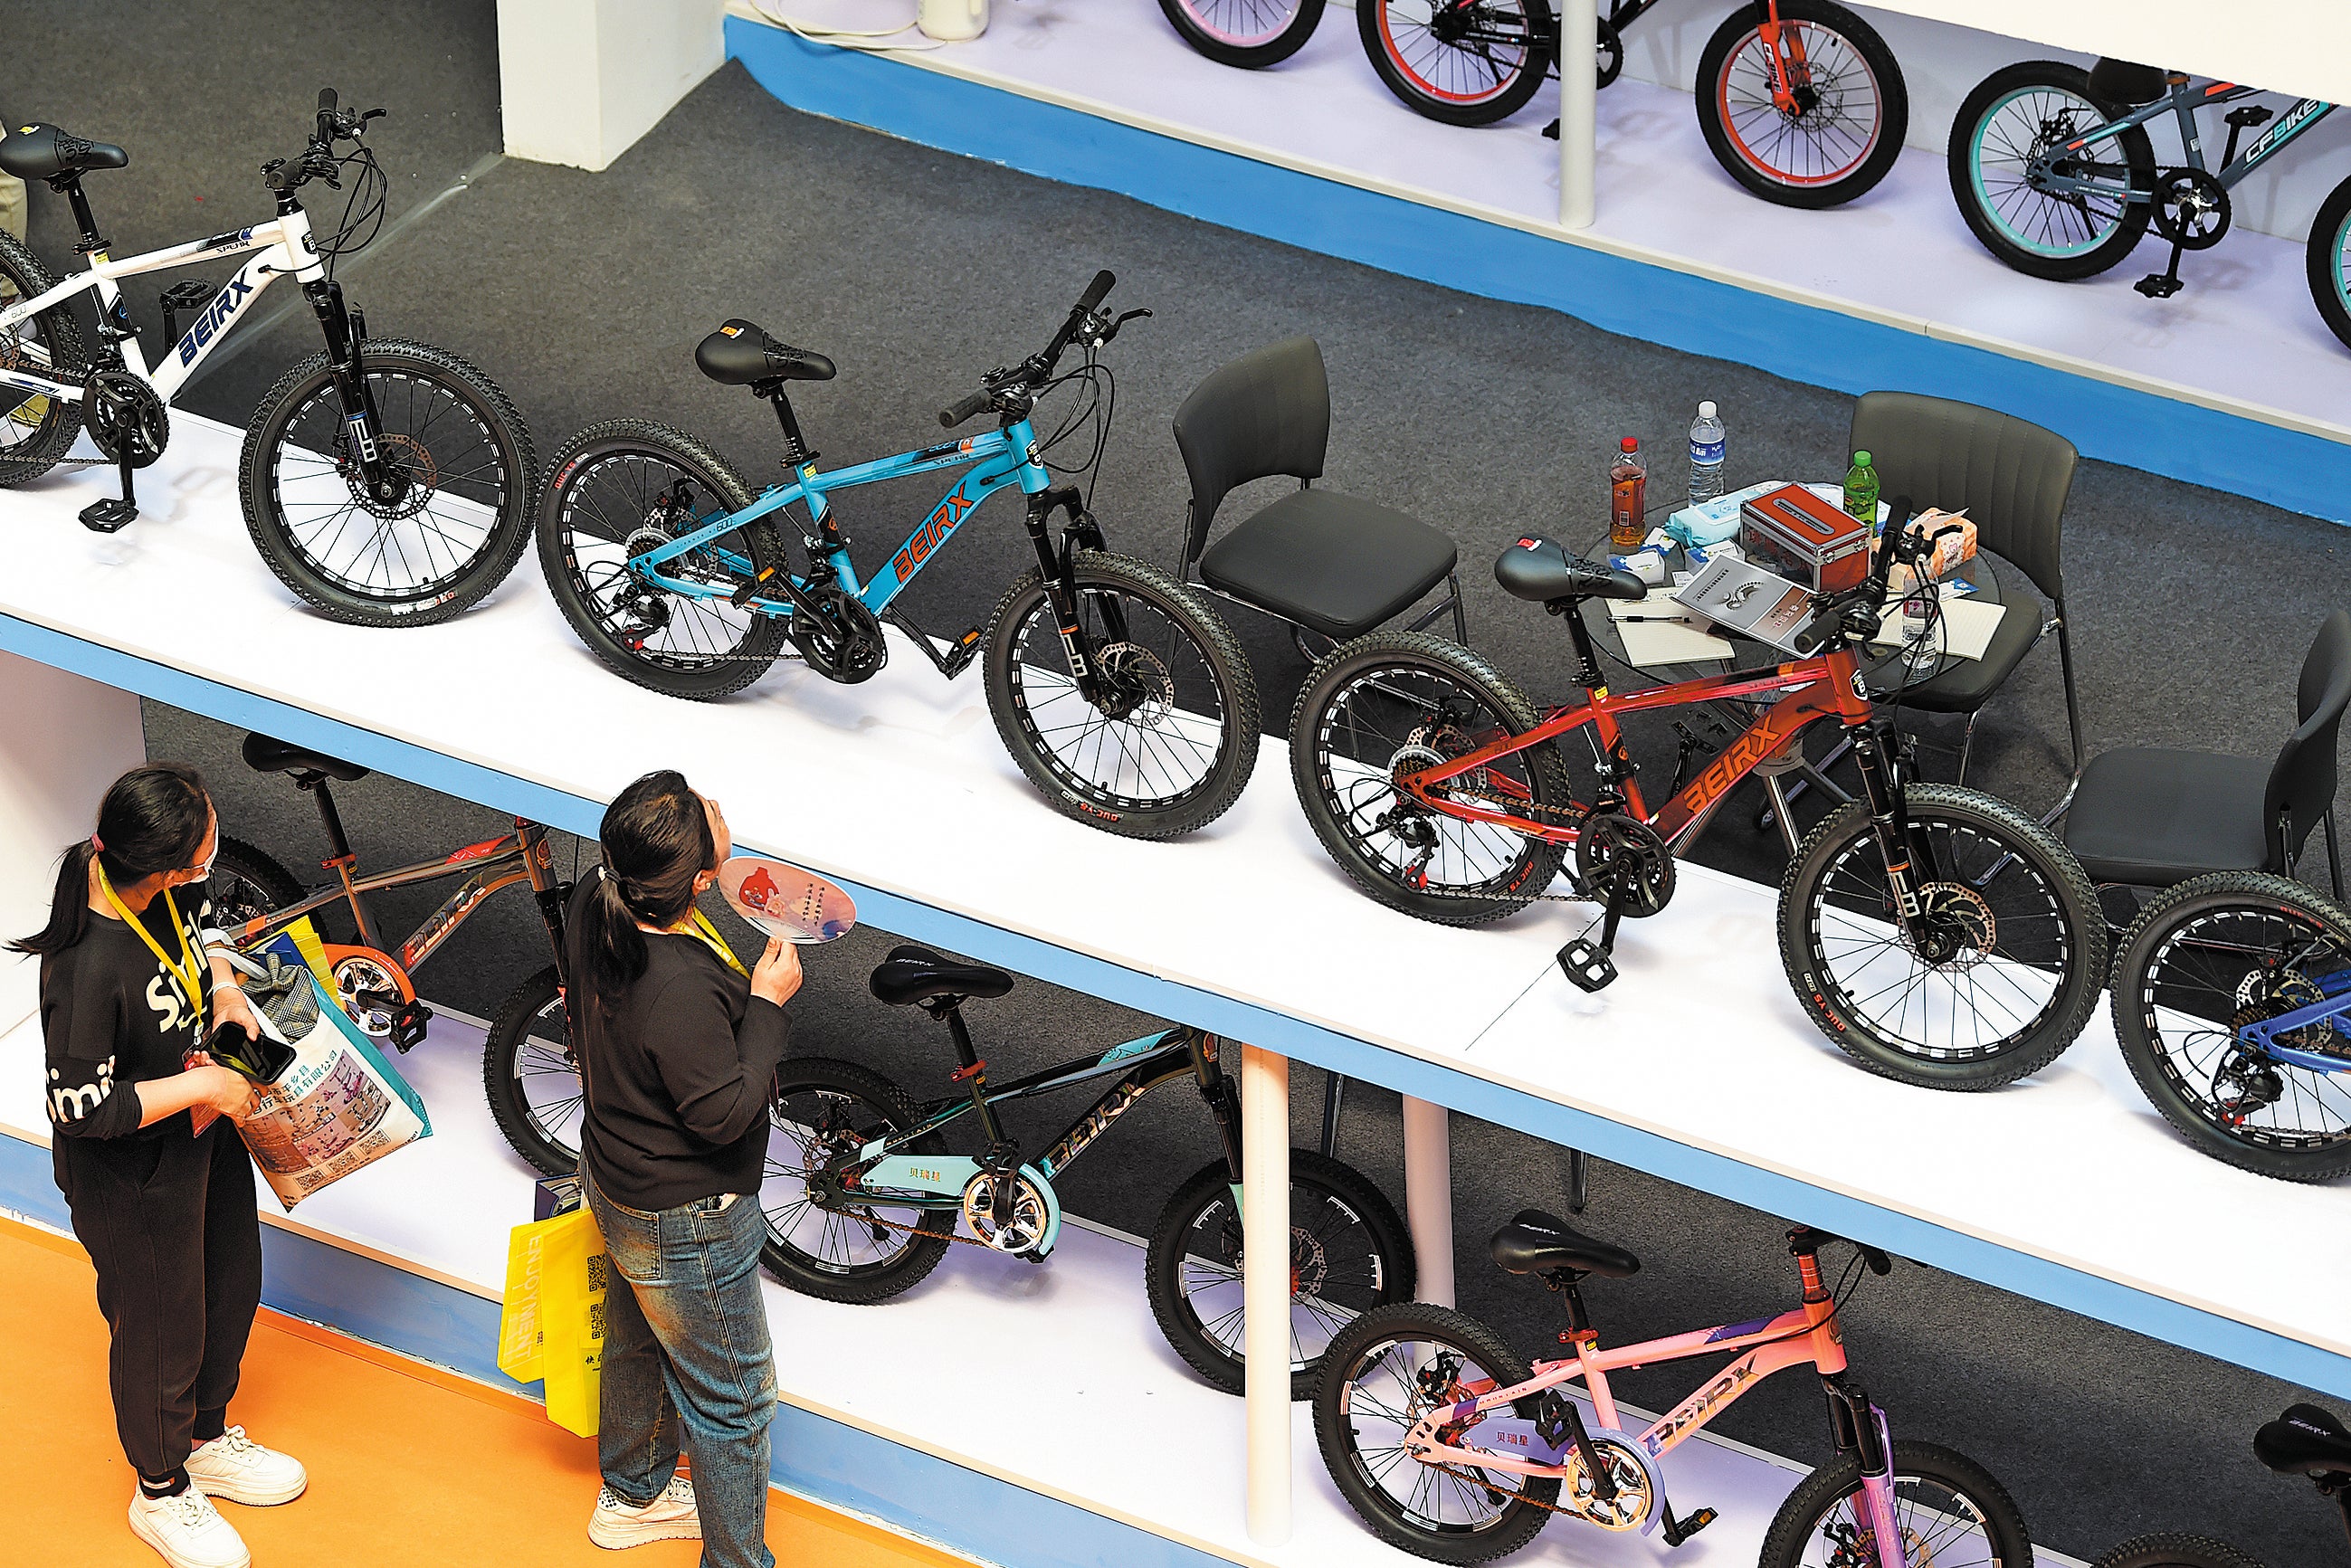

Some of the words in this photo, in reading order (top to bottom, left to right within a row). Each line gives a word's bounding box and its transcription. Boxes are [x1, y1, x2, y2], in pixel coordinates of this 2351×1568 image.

[2245, 99, 2318, 163] CFBIKE
[178, 266, 253, 368] BEIRX
[892, 480, 975, 584] BEIRX
[1683, 712, 1781, 815] BEIRX
[267, 1064, 309, 1097] 市平乡县
[516, 1234, 542, 1358] ENJOYMENT
[1497, 1431, 1529, 1447] 贝瑞星
